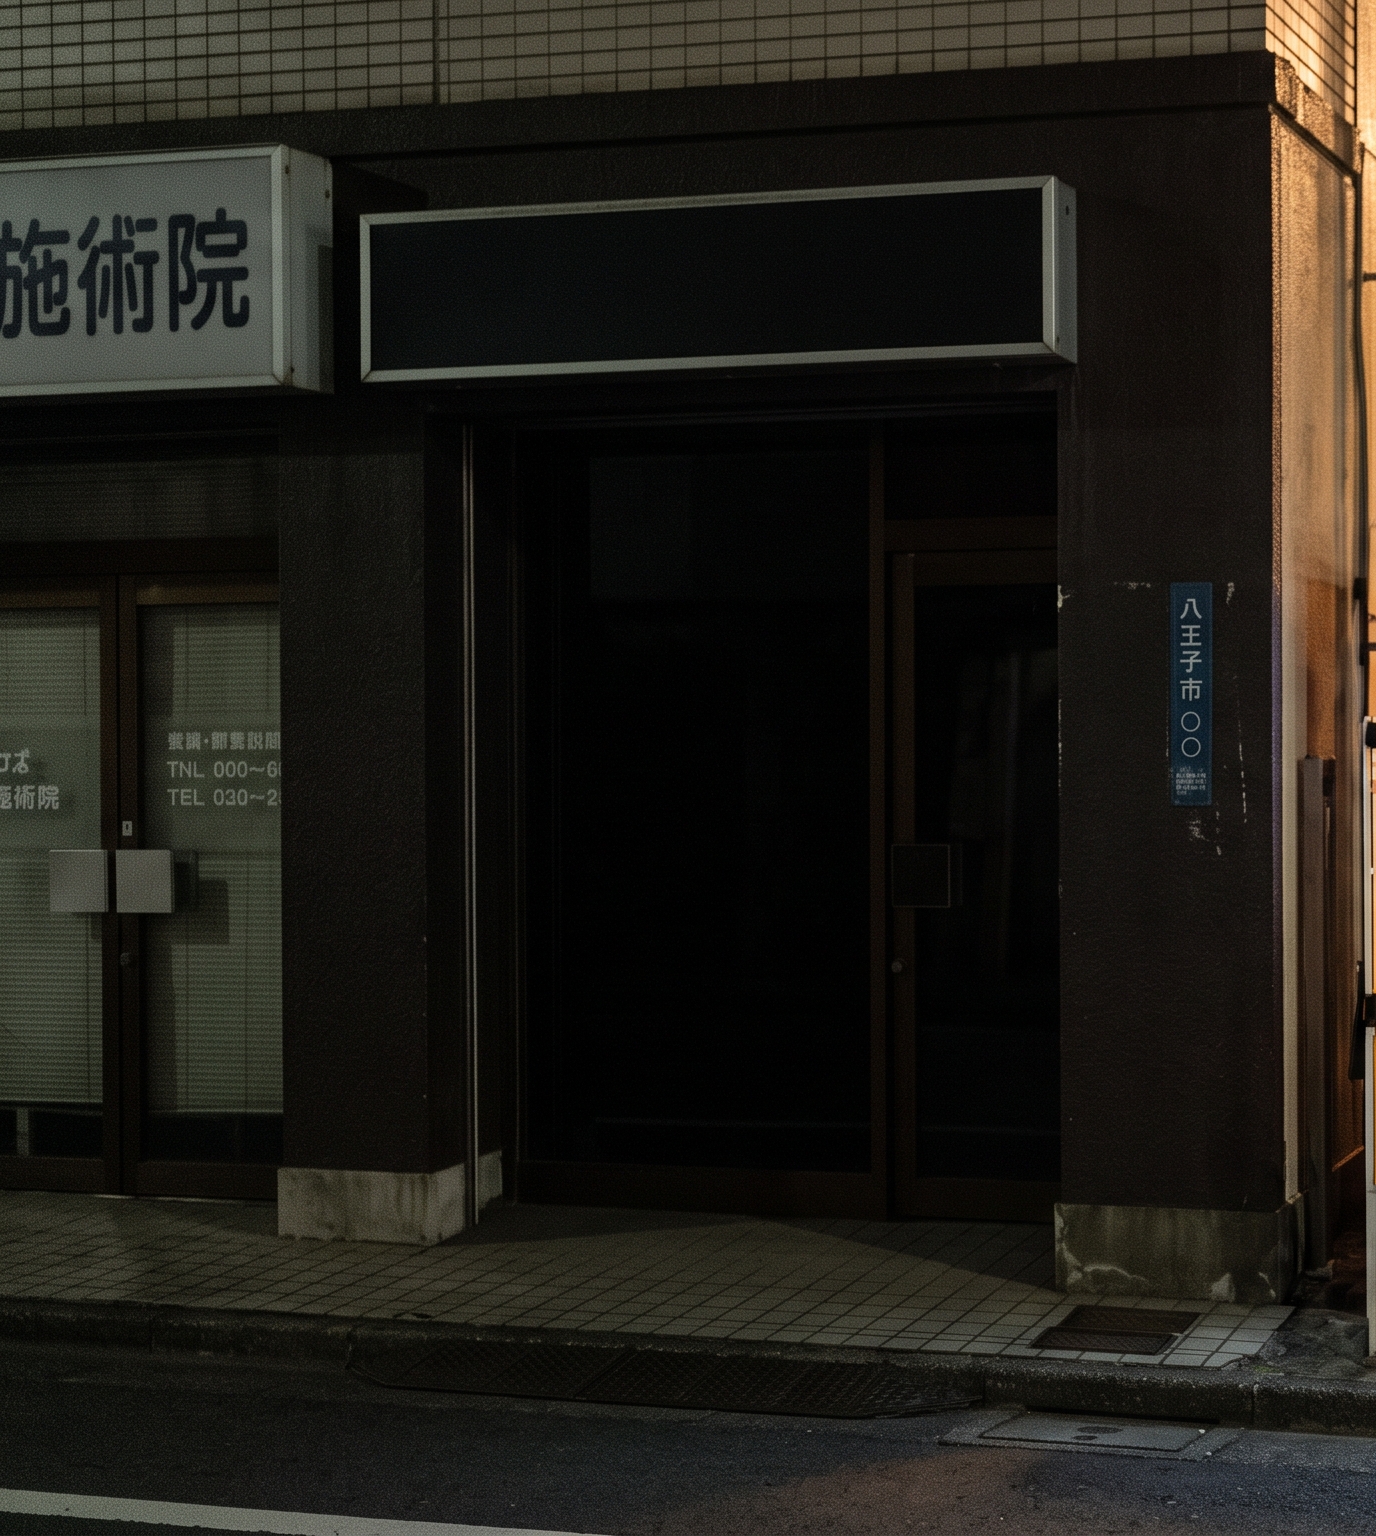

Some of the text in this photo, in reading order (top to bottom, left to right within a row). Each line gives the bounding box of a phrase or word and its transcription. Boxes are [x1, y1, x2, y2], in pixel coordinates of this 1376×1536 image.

[0, 207, 250, 339] 施術院
[167, 761, 205, 778] TNL
[167, 789, 205, 806] TEL
